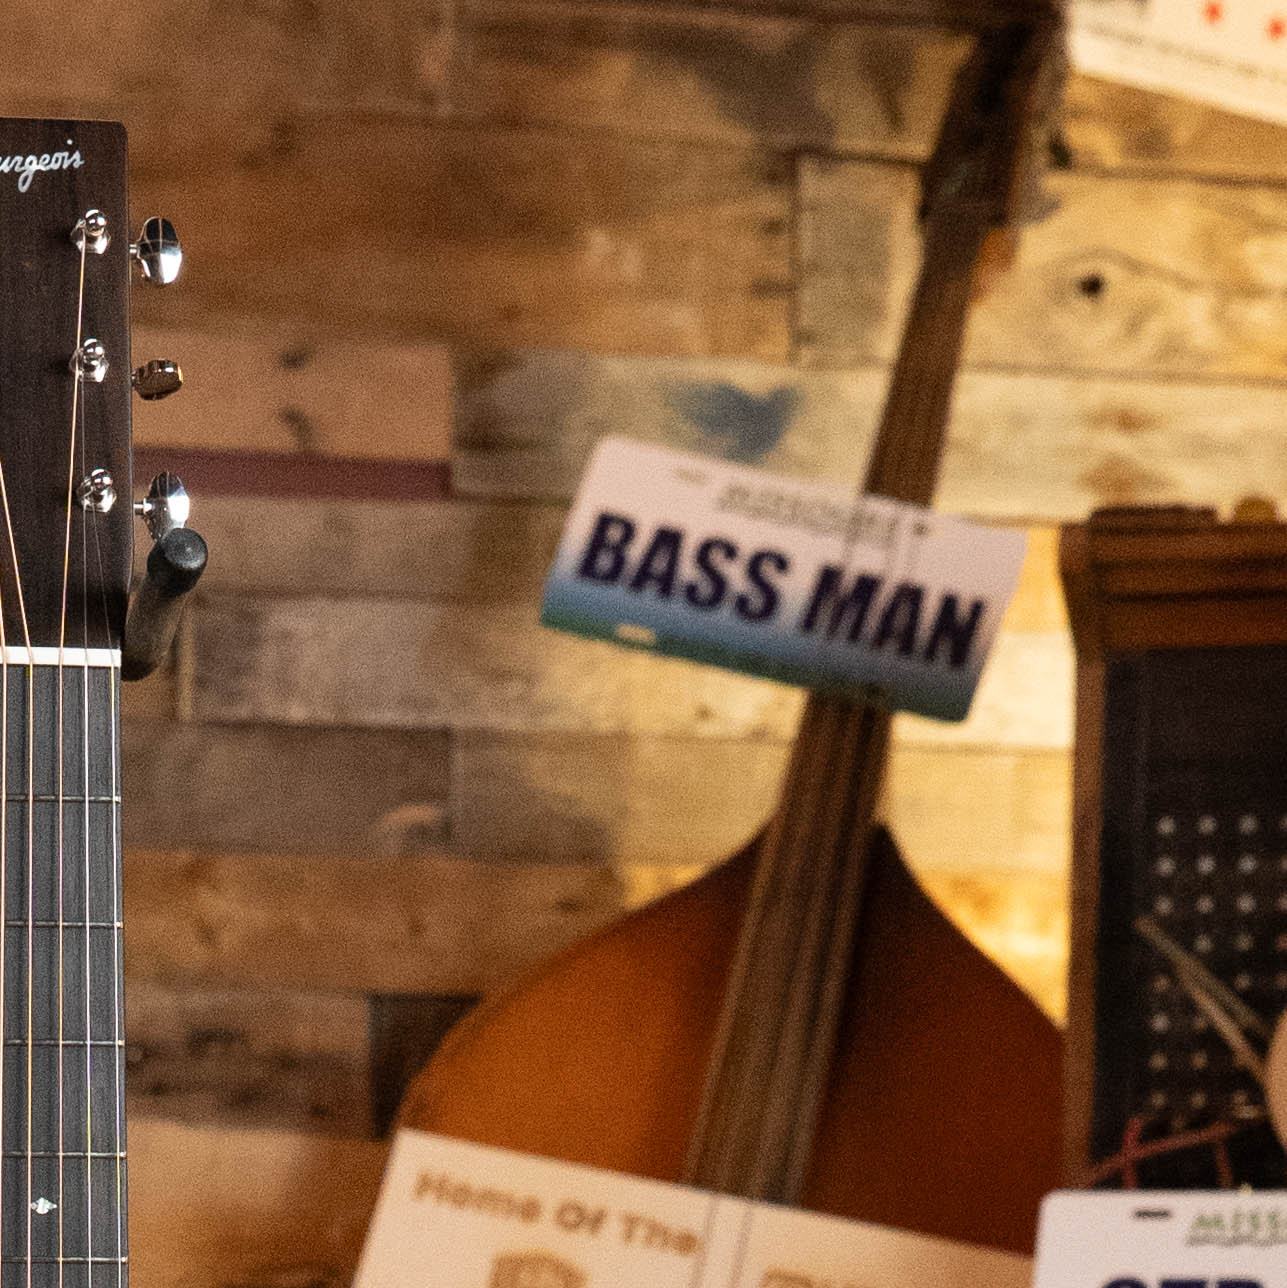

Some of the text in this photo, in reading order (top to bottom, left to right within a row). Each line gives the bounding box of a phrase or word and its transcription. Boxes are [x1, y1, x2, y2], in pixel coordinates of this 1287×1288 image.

[575, 510, 790, 622] BASS
[801, 562, 985, 669] MAN
[415, 1168, 543, 1229] Home
[618, 1211, 704, 1257] The
